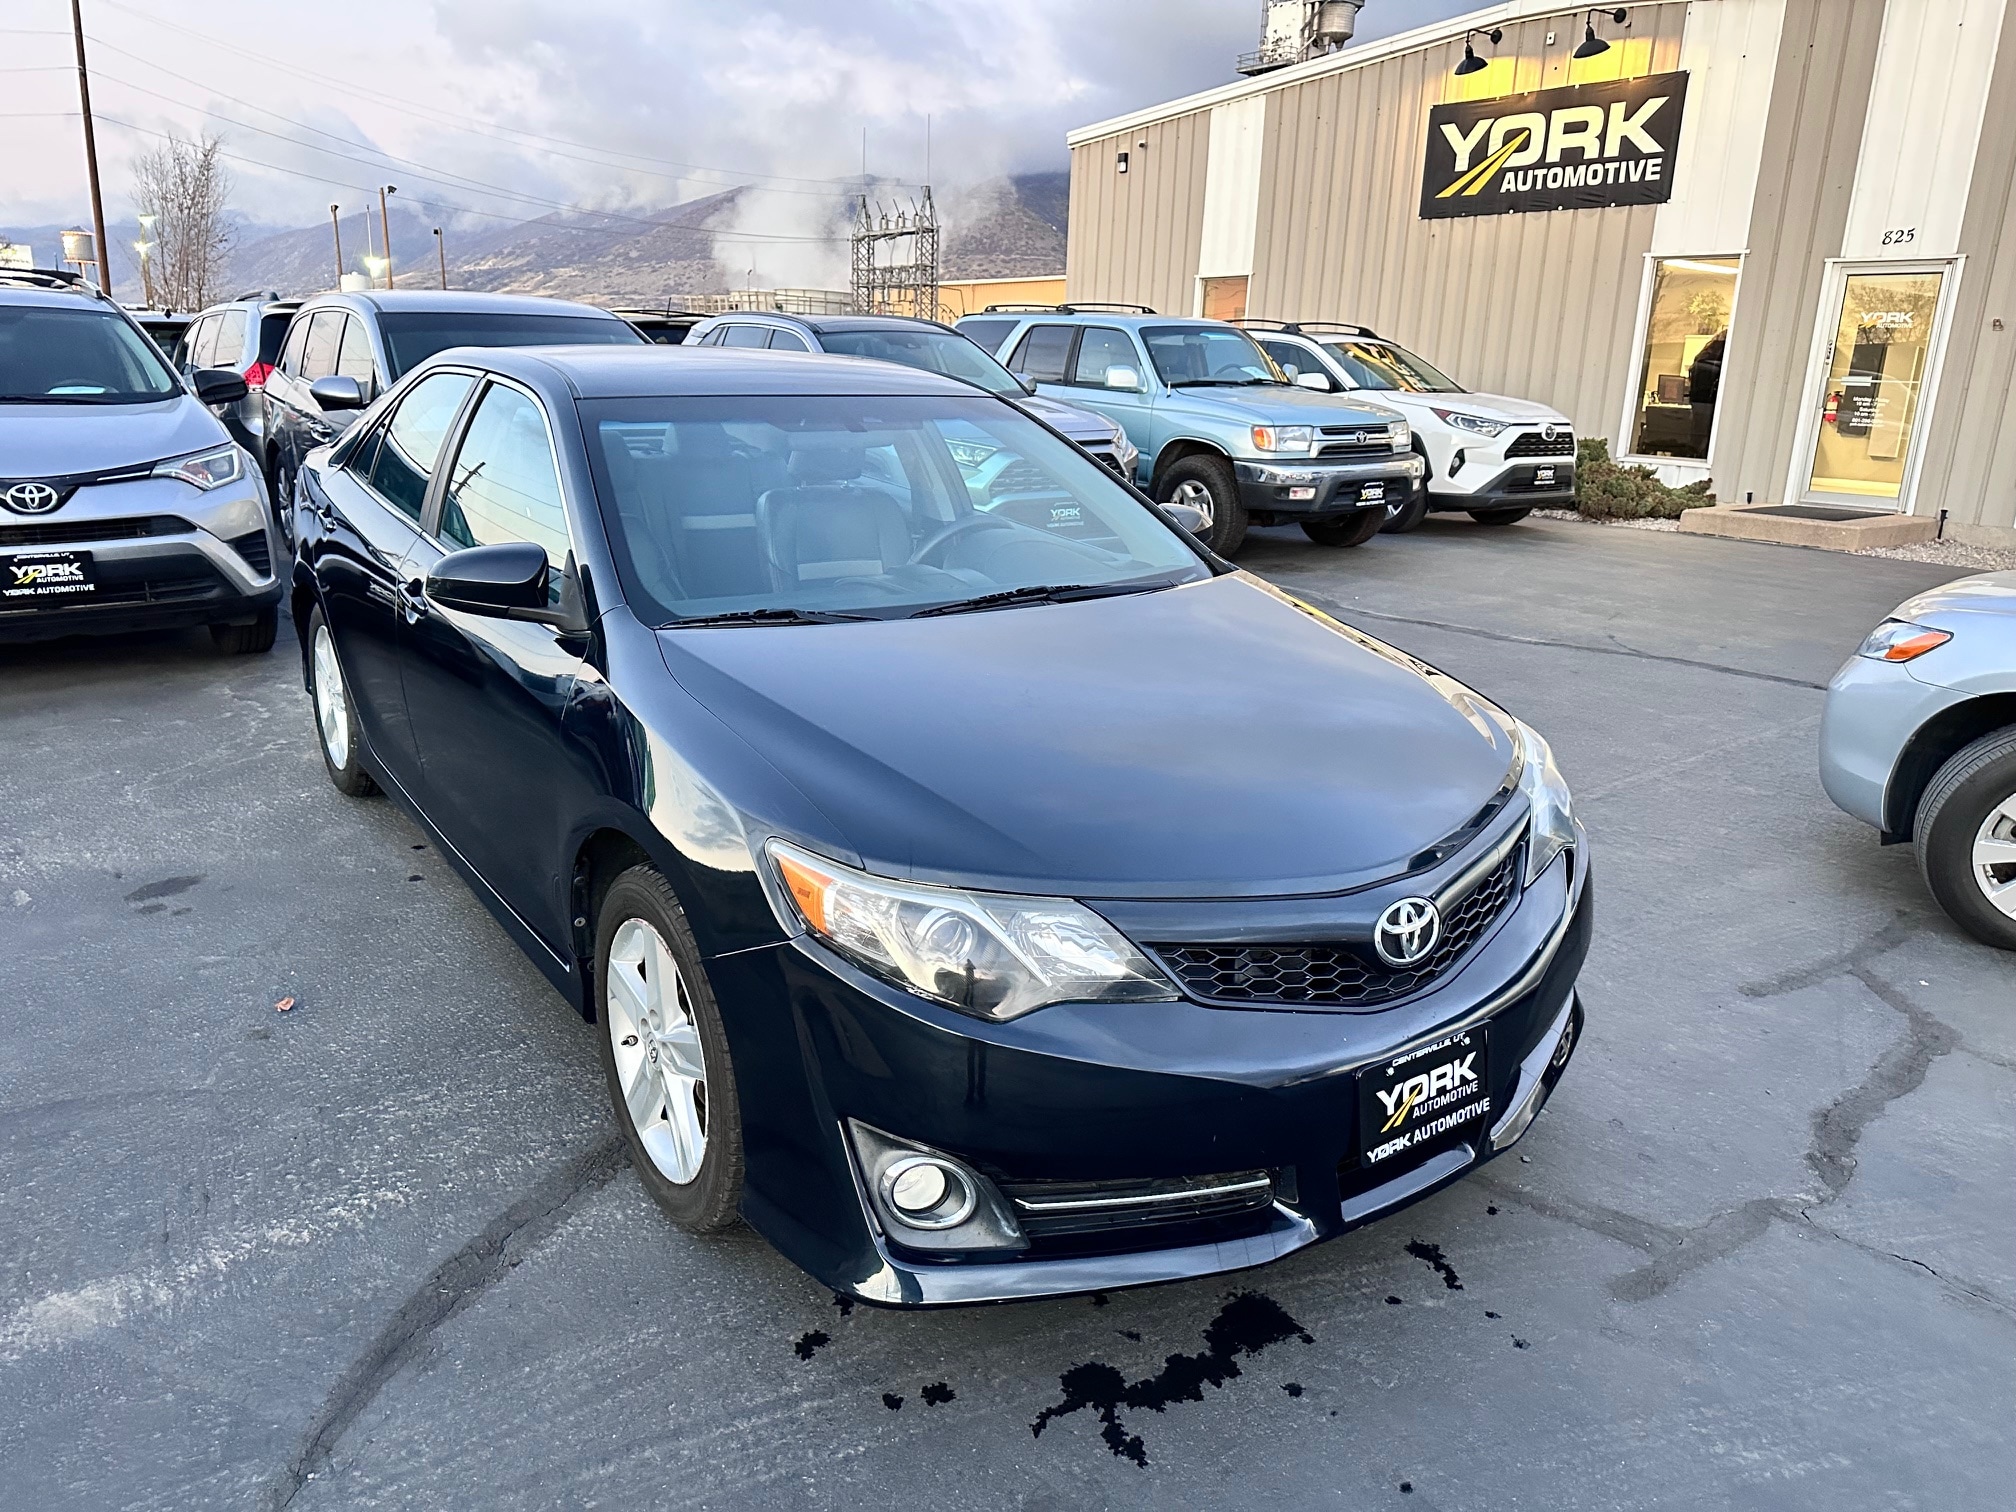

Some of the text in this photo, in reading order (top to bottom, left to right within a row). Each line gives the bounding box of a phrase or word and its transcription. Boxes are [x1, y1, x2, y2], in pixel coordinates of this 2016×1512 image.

[1440, 97, 1670, 172] YORK
[1500, 158, 1662, 193] AUTOMOTIVE
[1882, 228, 1915, 245] 825
[1860, 311, 1915, 323] YORK
[1050, 508, 1080, 517] YORK
[9, 562, 83, 578] YORK
[36, 574, 84, 583] AUTOMOTIVE
[3, 584, 95, 596] YORK AUTOMOTIVE
[1376, 1051, 1478, 1116] YORK
[1412, 1080, 1479, 1119] AUTOMOTIVE
[1366, 1097, 1490, 1163] YORK AUTOMOTIVE
